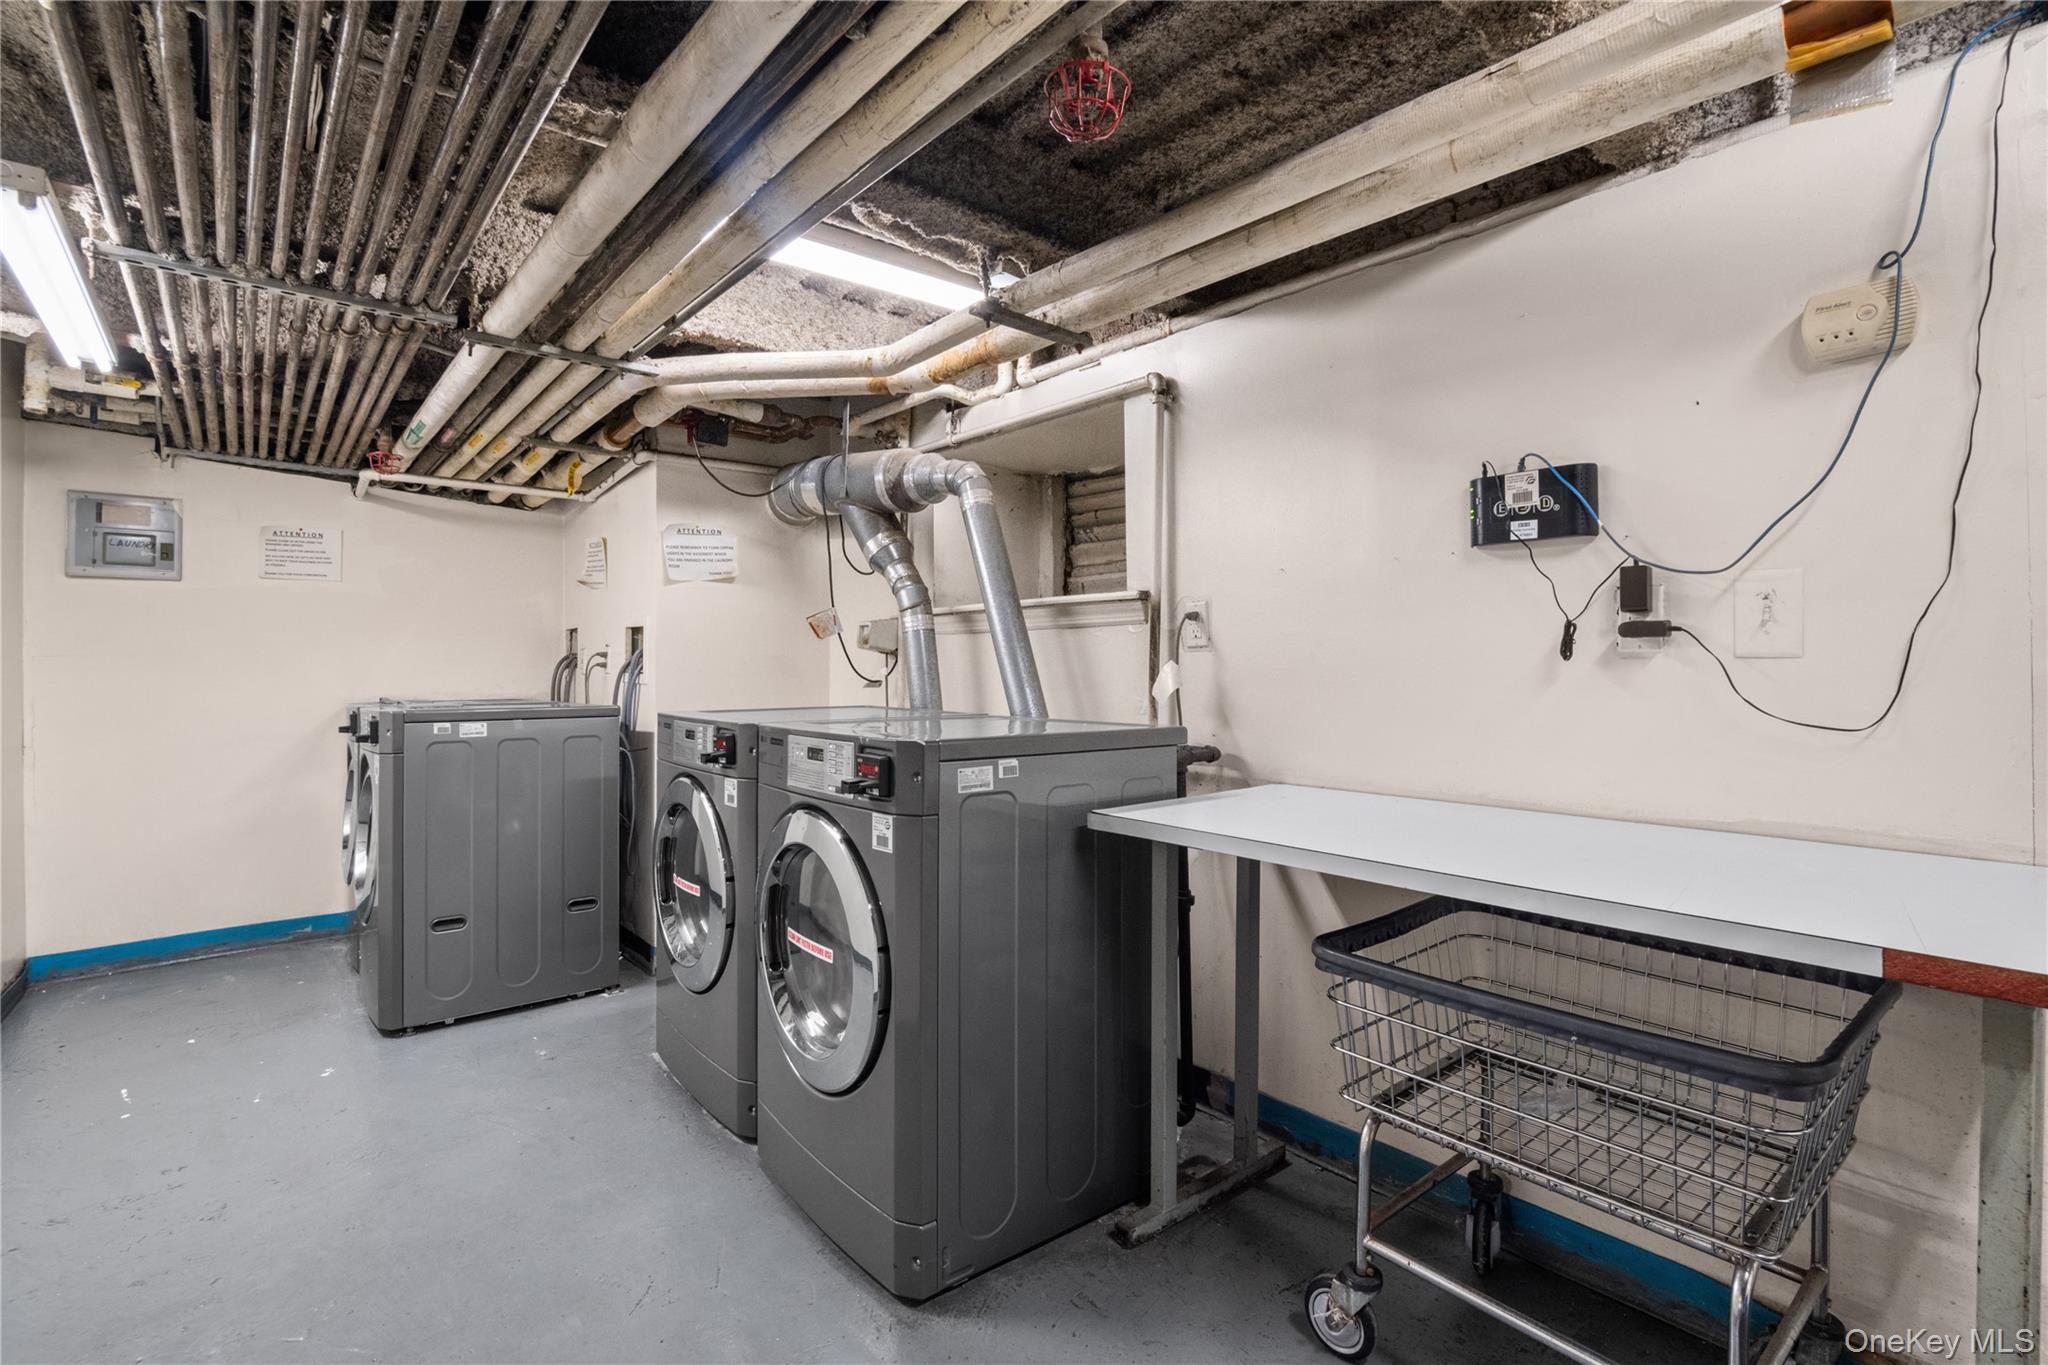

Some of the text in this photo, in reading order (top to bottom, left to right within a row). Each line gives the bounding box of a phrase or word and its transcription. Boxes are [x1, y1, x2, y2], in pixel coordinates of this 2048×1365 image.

[273, 530, 324, 539] ATTENTION
[677, 528, 722, 536] ATTENTION
[109, 538, 155, 550] LAUNDRY
